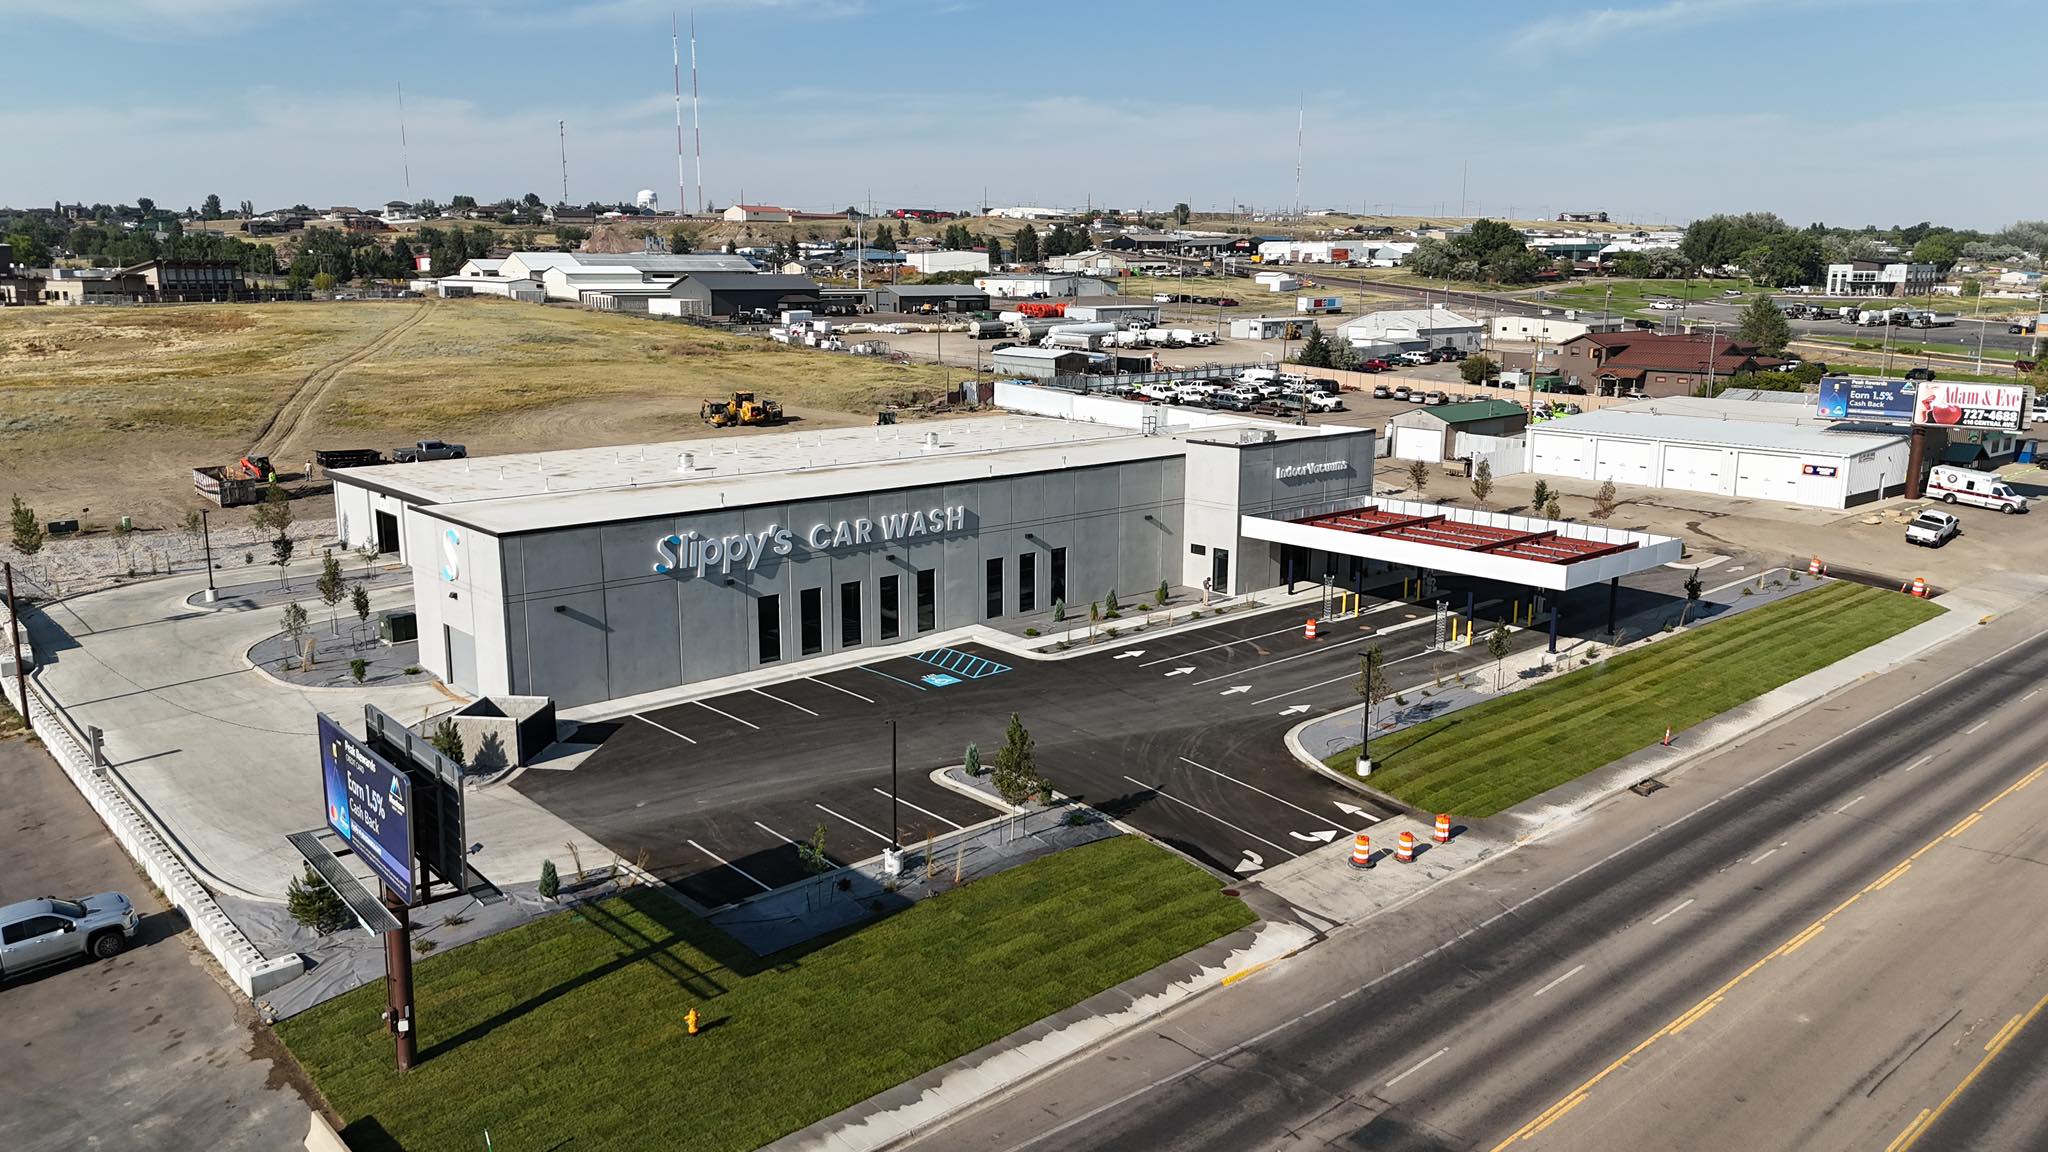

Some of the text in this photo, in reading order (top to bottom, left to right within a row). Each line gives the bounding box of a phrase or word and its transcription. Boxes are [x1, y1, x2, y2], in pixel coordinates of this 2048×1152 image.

[1850, 391, 1870, 400] Earn
[1873, 391, 1894, 401] 1.5%
[1945, 386, 2020, 407] Adam & Eve
[1963, 409, 2018, 422] 727-4688
[654, 505, 965, 578] Slippy's CAR WASH
[345, 740, 376, 773] Peak Rewards
[347, 770, 365, 802] Earn
[365, 784, 386, 820] 1.5%
[350, 798, 365, 821] Cash
[364, 810, 380, 835] Back
